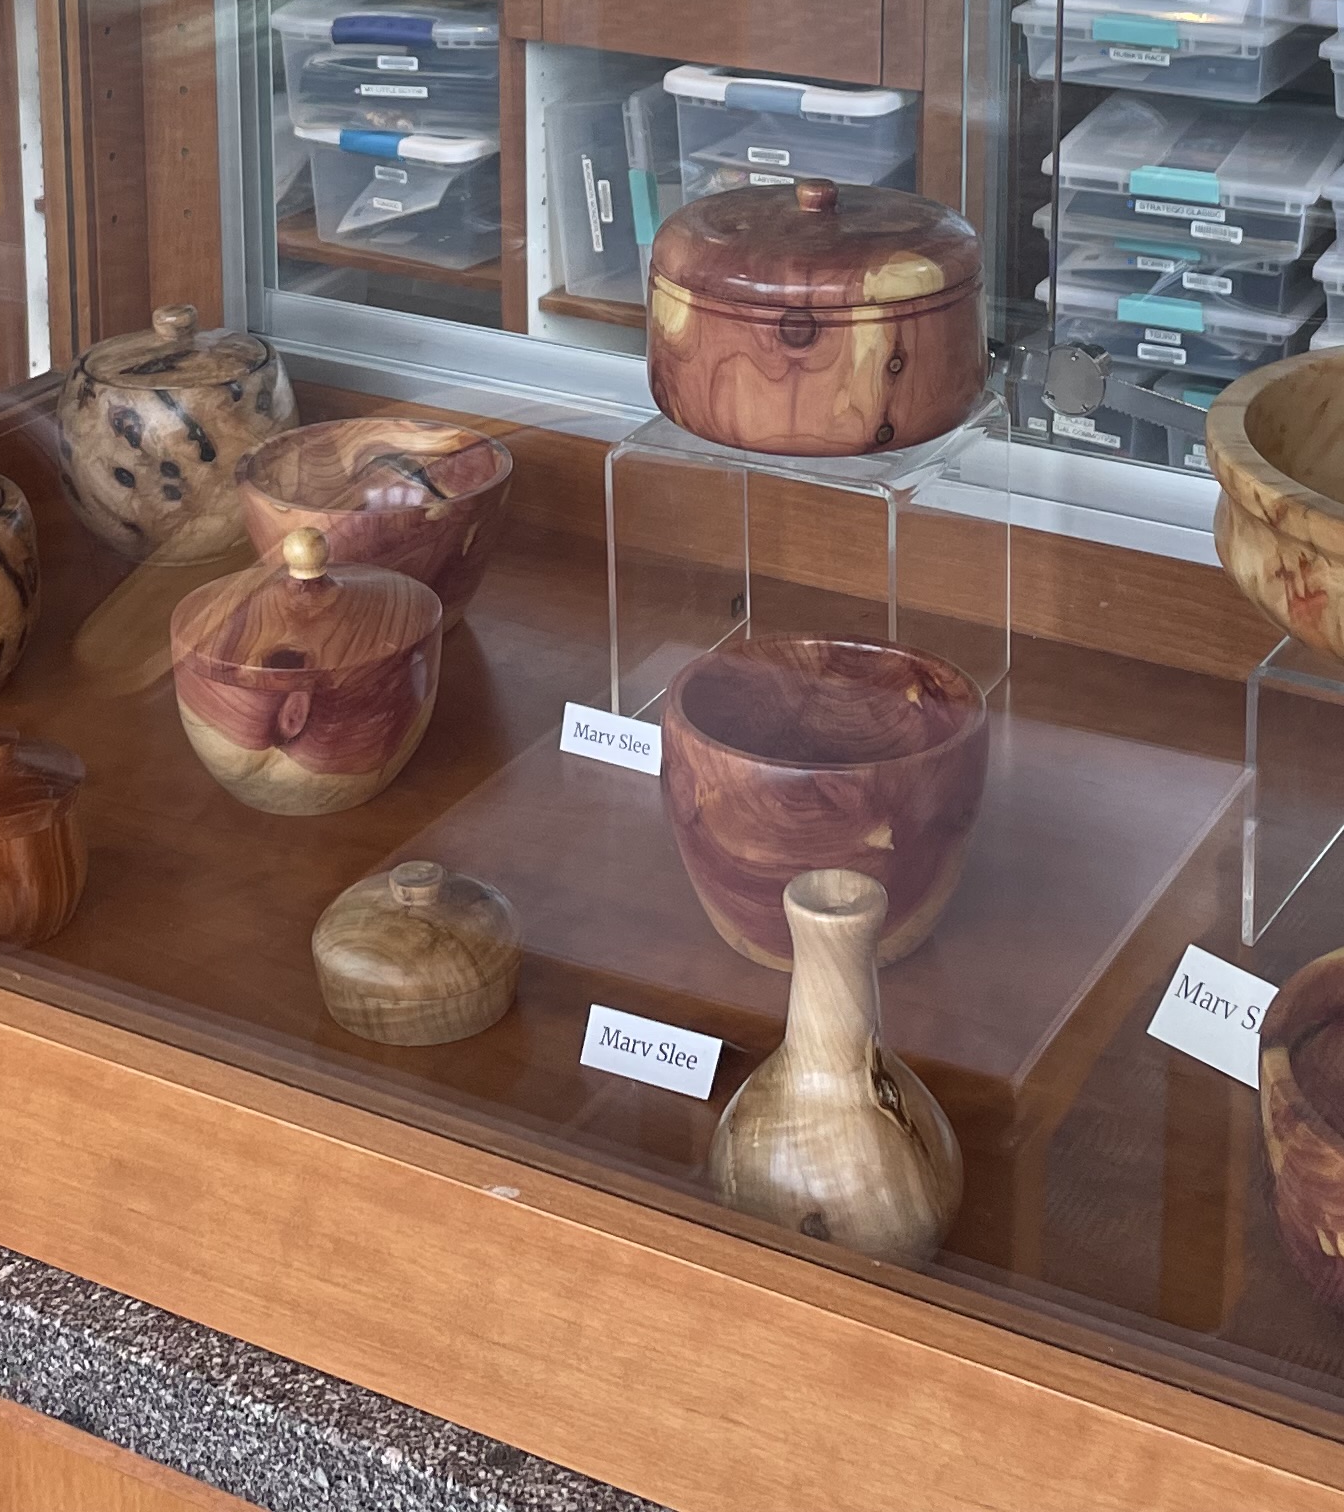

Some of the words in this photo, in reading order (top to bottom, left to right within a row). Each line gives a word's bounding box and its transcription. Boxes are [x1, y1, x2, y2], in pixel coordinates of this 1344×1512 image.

[1144, 52, 1167, 62] RACE
[1139, 201, 1184, 215] STRATEGO
[573, 722, 615, 745] Marv
[619, 734, 651, 756] Slee
[1174, 973, 1238, 1020] Marv
[599, 1025, 653, 1057] Marv
[656, 1042, 698, 1070] Slee
